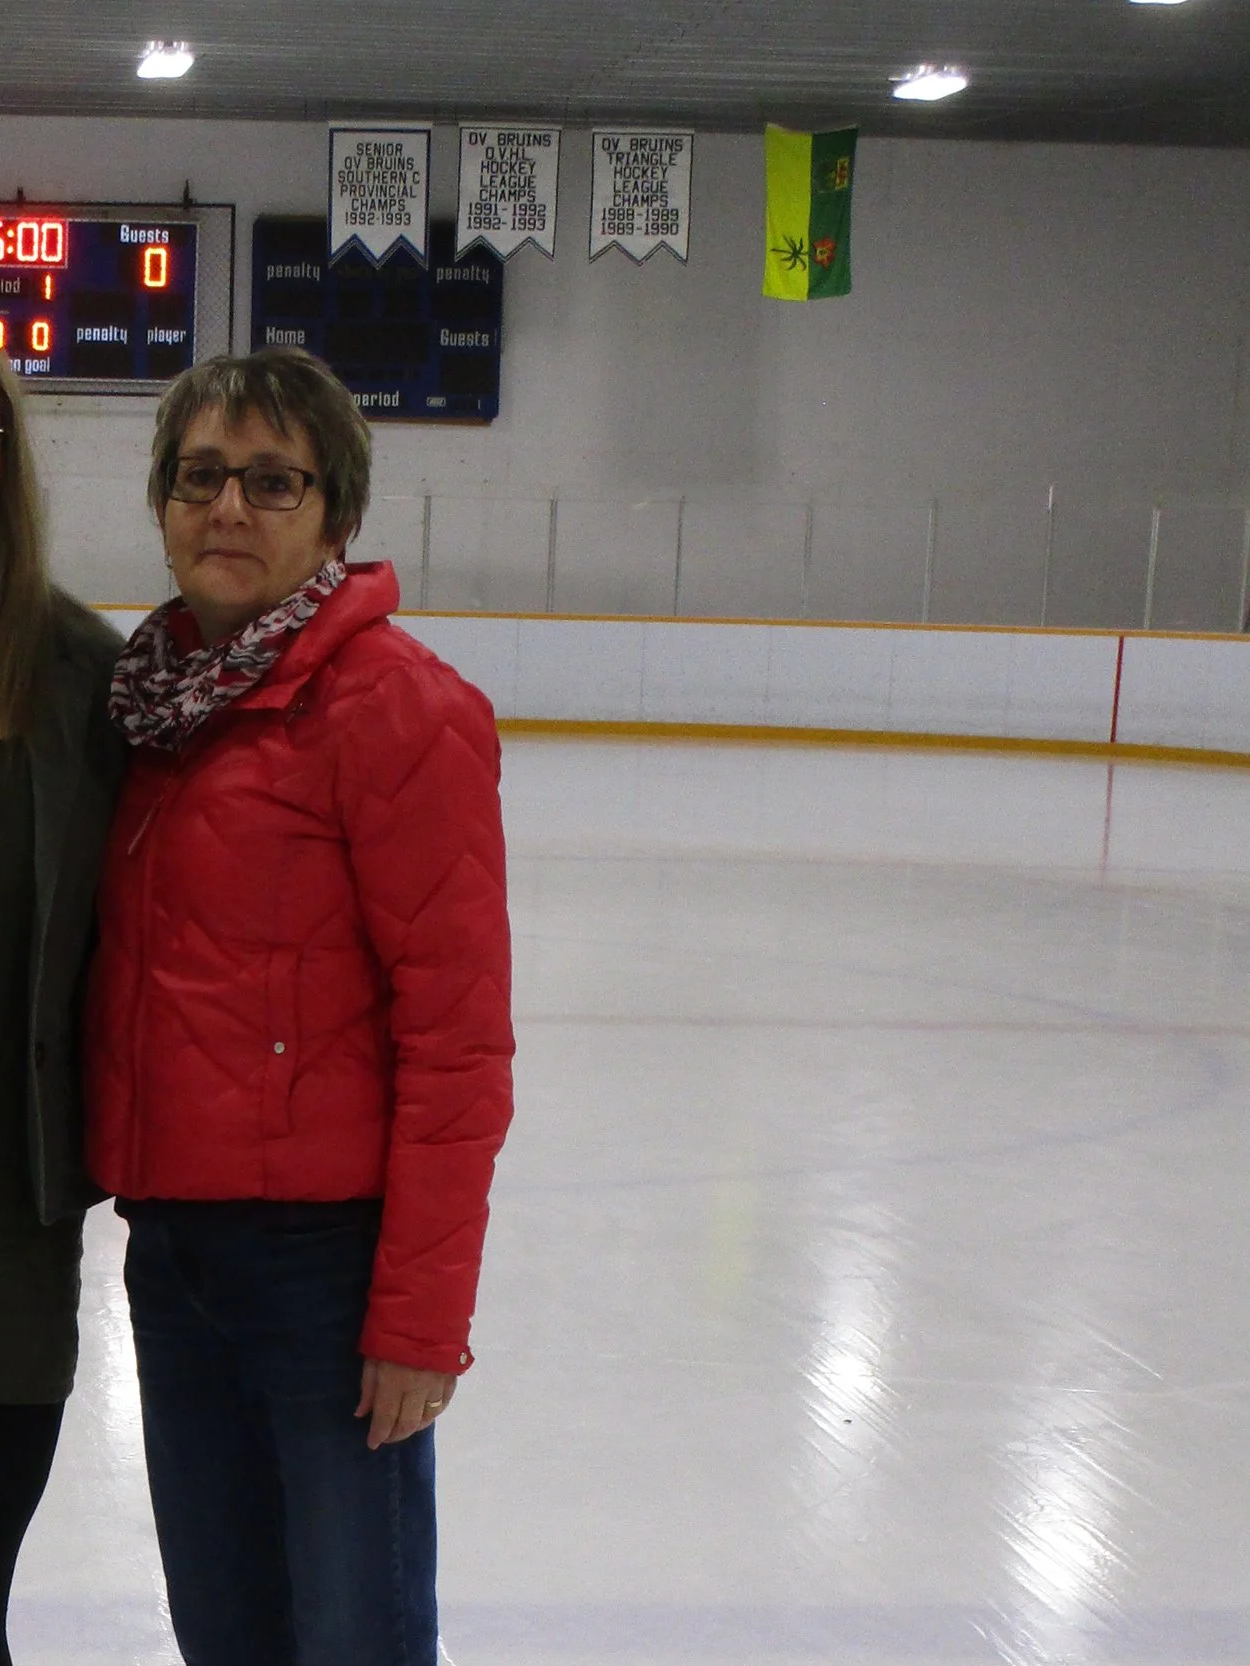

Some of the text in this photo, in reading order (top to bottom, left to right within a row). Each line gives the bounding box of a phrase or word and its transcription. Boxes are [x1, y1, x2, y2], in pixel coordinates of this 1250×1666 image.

[469, 132, 551, 146] OV BRUINS
[602, 138, 683, 152] OV BRUINS
[357, 143, 402, 156] SENIOR
[344, 157, 414, 170] OV BRUINS
[607, 152, 678, 165] TRIANGLE
[481, 161, 536, 174] HOCKEY
[614, 167, 668, 179] HOCKEY
[338, 171, 420, 184] SOUTHERN C
[480, 175, 537, 188] LEAGUE
[341, 185, 417, 198] PROVINCIAL
[613, 181, 668, 193] LEAGUE
[479, 189, 535, 203] CHAMPS
[613, 195, 668, 207] CHAMPS
[352, 199, 405, 212] CHAMPS
[345, 212, 411, 225] 1992-1993
[602, 208, 679, 221] 1988-1989
[120, 224, 169, 244] Guests
[601, 222, 679, 235] 1989-1990
[144, 248, 166, 287] 0
[267, 263, 320, 281] penalty
[436, 265, 490, 284] penalty
[32, 322, 49, 351] 0
[77, 326, 127, 344] penalty
[148, 327, 186, 345] player
[266, 327, 305, 344] Home
[440, 328, 489, 346] Guests
[25, 357, 50, 374] goal
